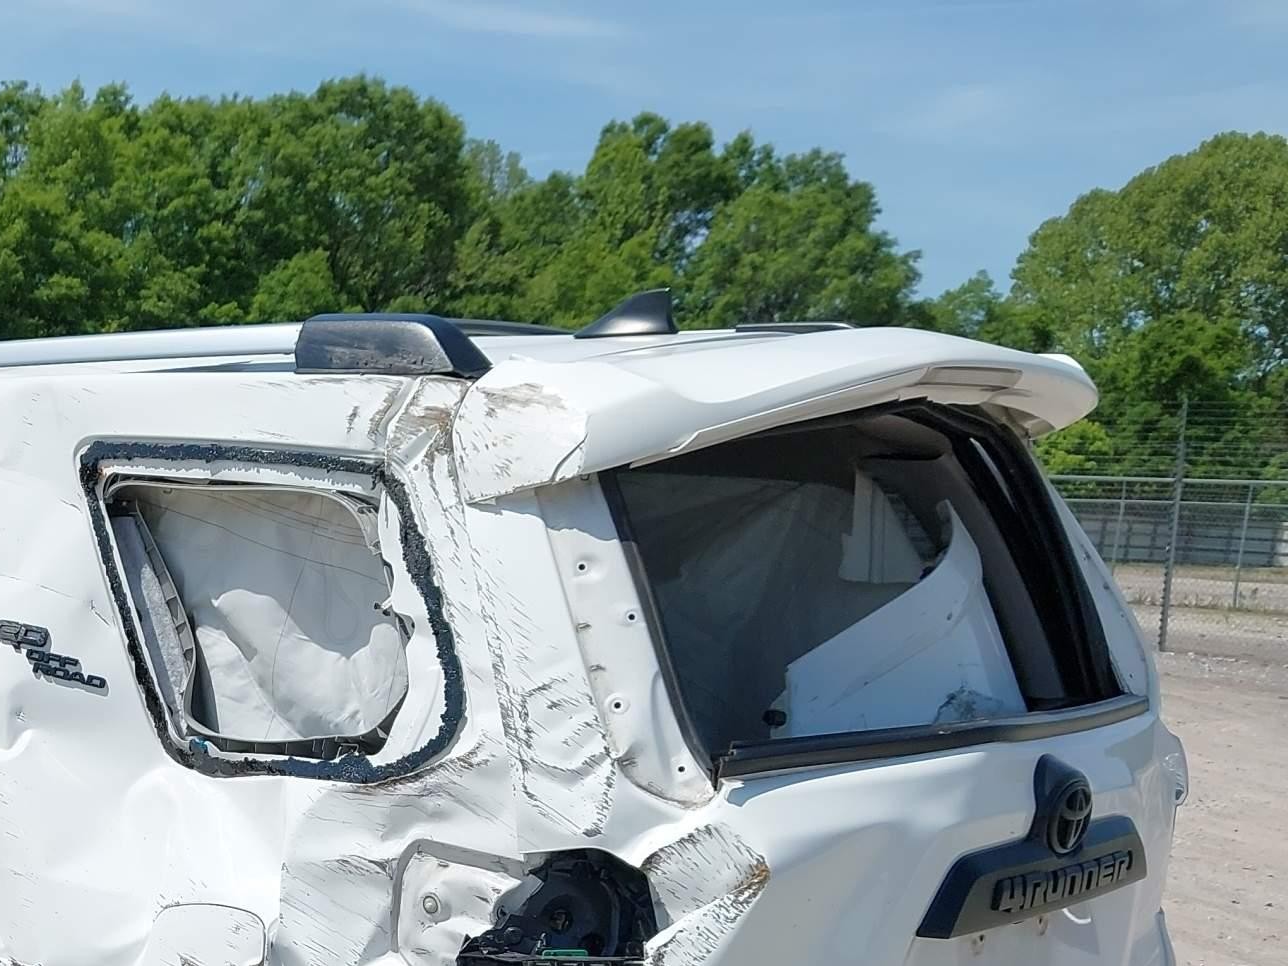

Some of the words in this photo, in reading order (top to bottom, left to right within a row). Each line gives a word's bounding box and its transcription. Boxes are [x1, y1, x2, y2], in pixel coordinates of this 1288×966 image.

[26, 648, 81, 670] OFF
[32, 662, 108, 693] ROAD
[992, 850, 1133, 913] 4RUNNER
